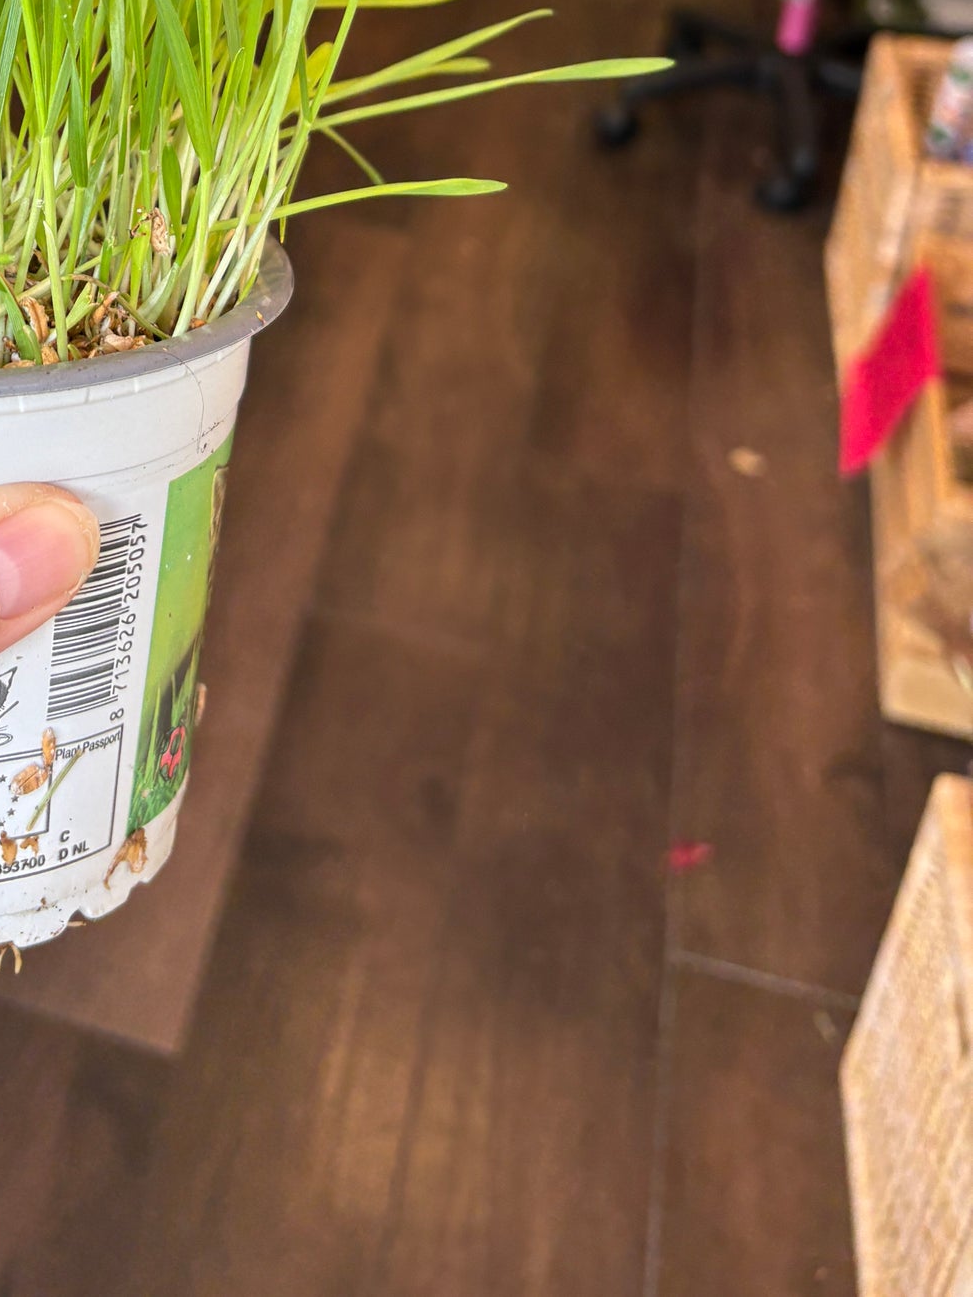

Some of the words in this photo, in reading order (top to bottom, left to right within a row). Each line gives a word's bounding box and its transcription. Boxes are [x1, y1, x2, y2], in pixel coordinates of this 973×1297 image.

[123, 522, 148, 604] 205057
[112, 612, 137, 696] 713626
[110, 707, 125, 722] 8
[55, 744, 81, 761] Plant
[82, 730, 121, 753] Passport
[59, 829, 70, 843] C
[58, 847, 69, 863] D
[71, 840, 91, 855] NL
